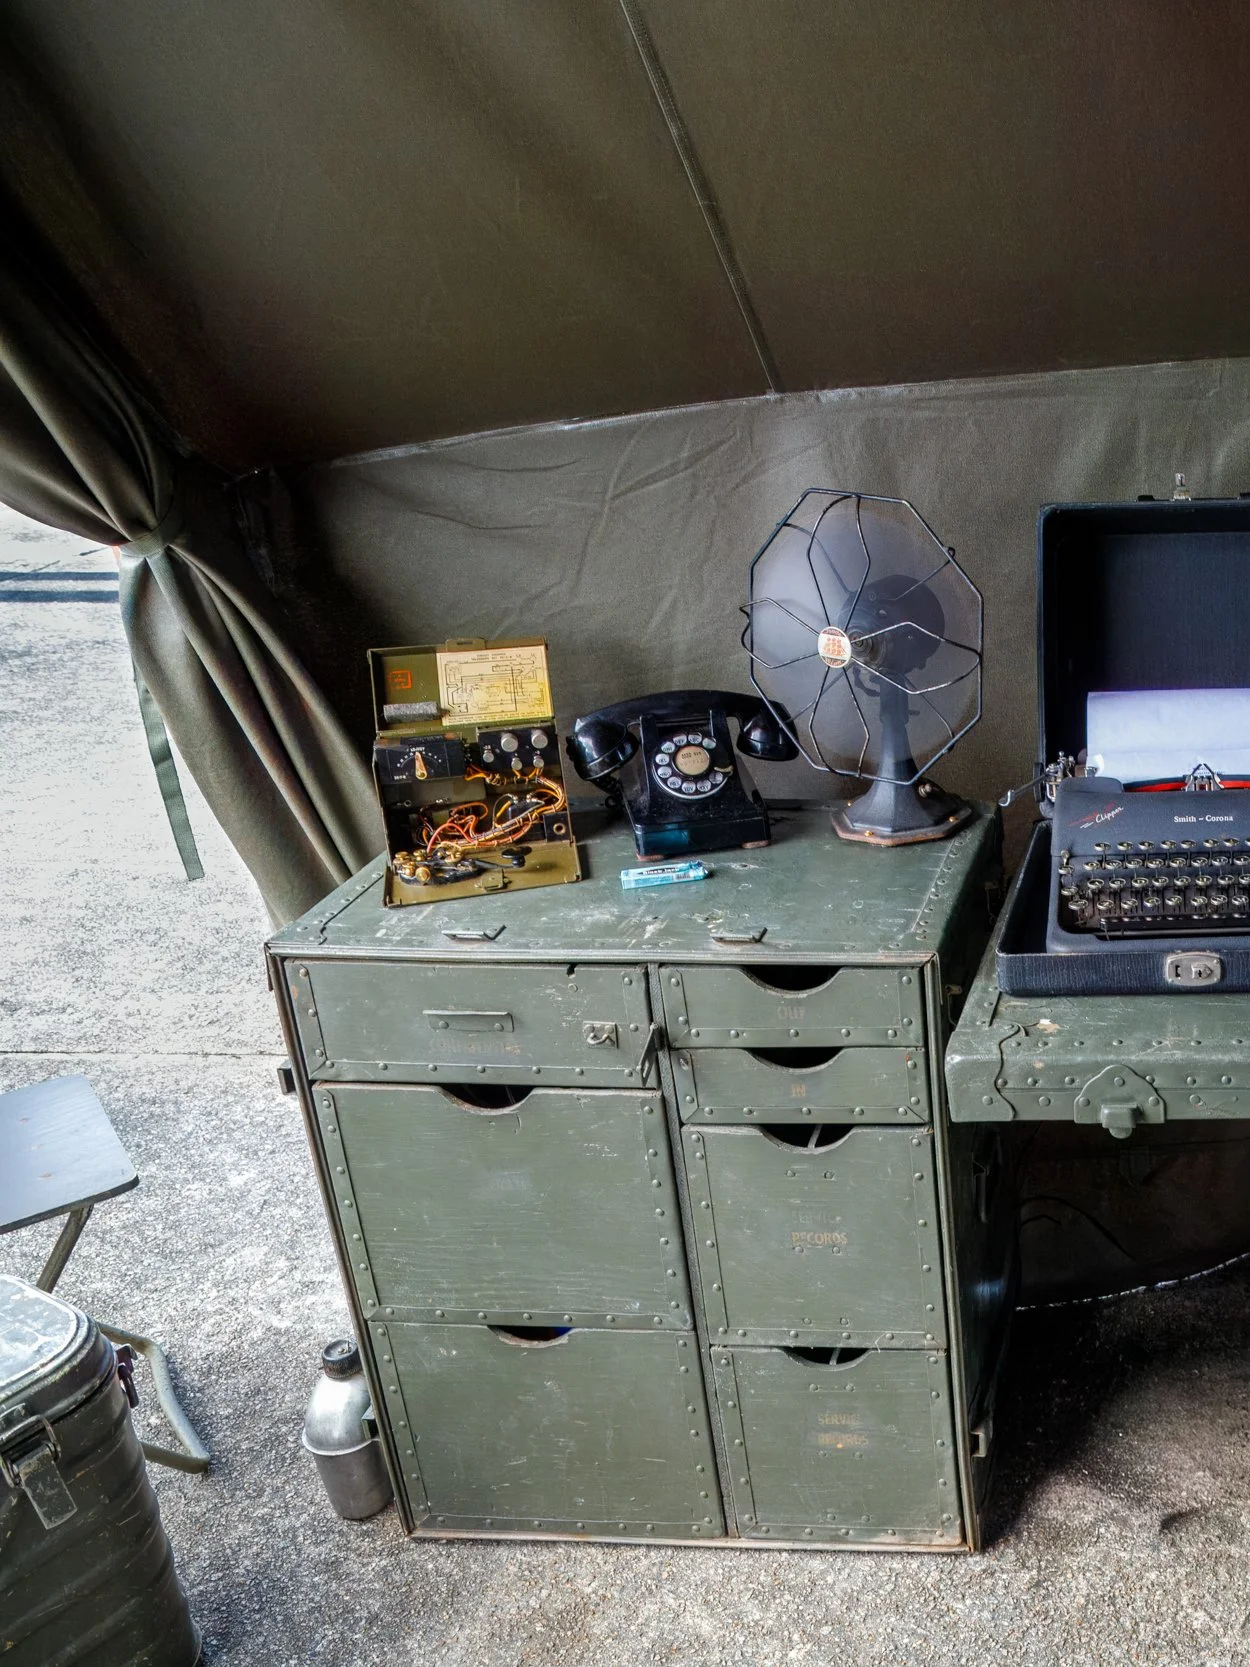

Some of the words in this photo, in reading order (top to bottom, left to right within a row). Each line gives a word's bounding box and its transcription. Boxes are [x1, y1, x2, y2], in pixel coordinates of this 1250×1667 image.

[1095, 805, 1124, 823] Clipper
[1174, 815, 1197, 823] Smith
[1205, 814, 1234, 822] Corona
